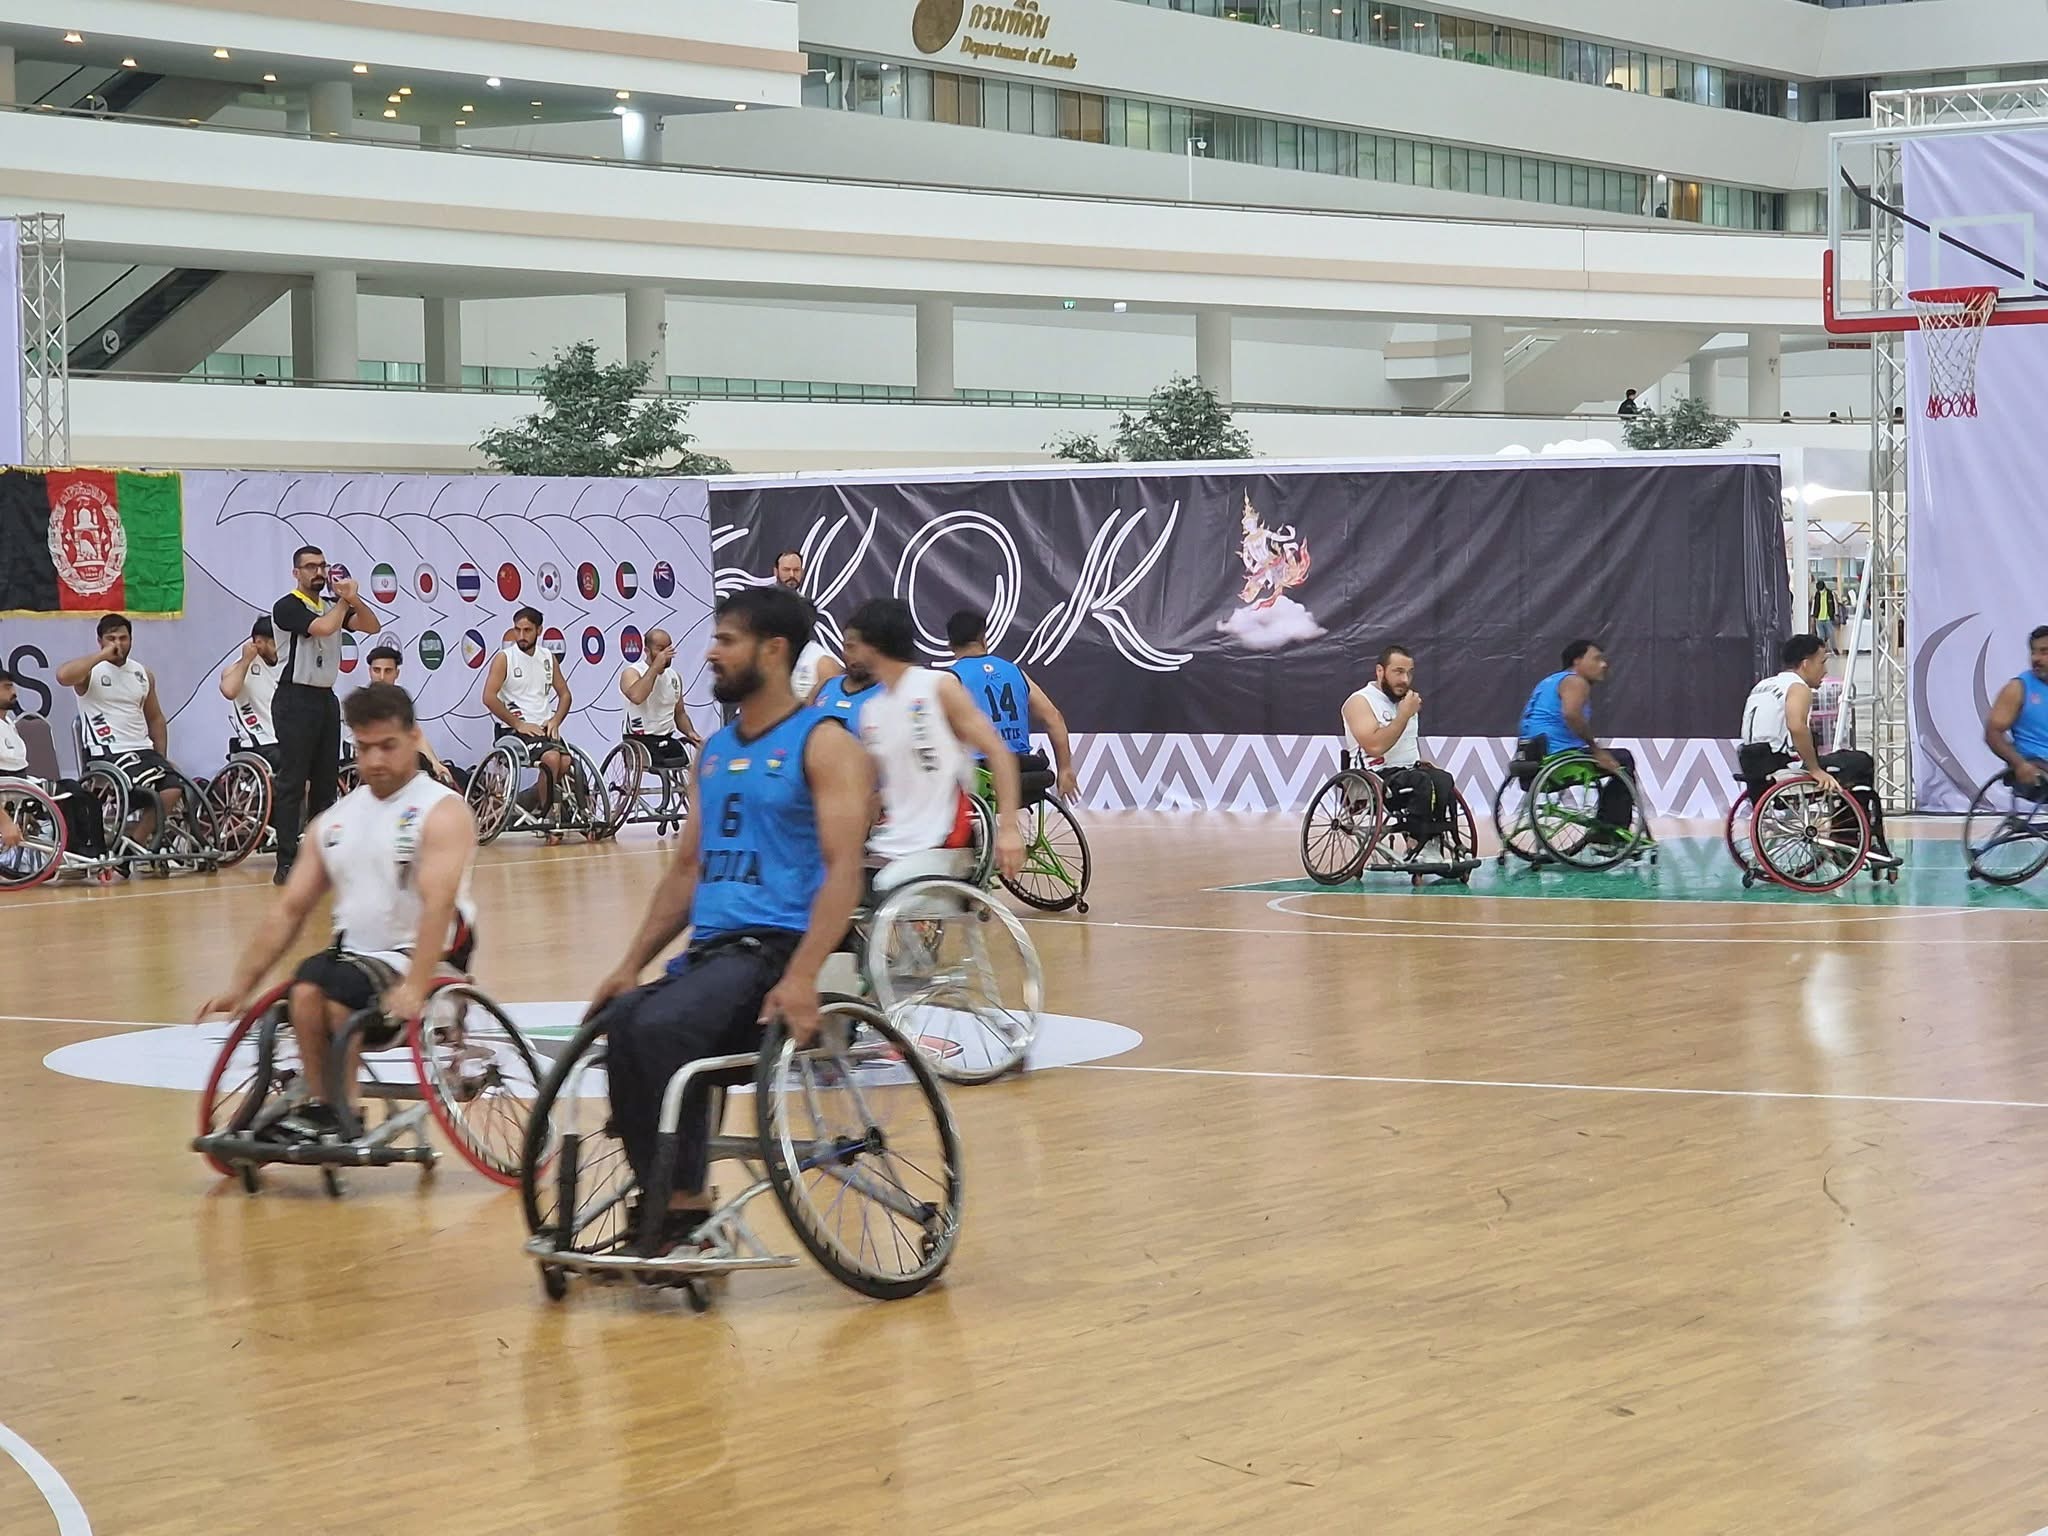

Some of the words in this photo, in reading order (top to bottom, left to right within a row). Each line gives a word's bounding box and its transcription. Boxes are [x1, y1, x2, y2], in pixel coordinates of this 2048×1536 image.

[960, 35, 1029, 60] Department
[1028, 47, 1045, 63] of
[1042, 48, 1078, 69] Lands
[984, 682, 1019, 722] 14
[91, 712, 116, 743] WBF
[720, 793, 743, 837] 6
